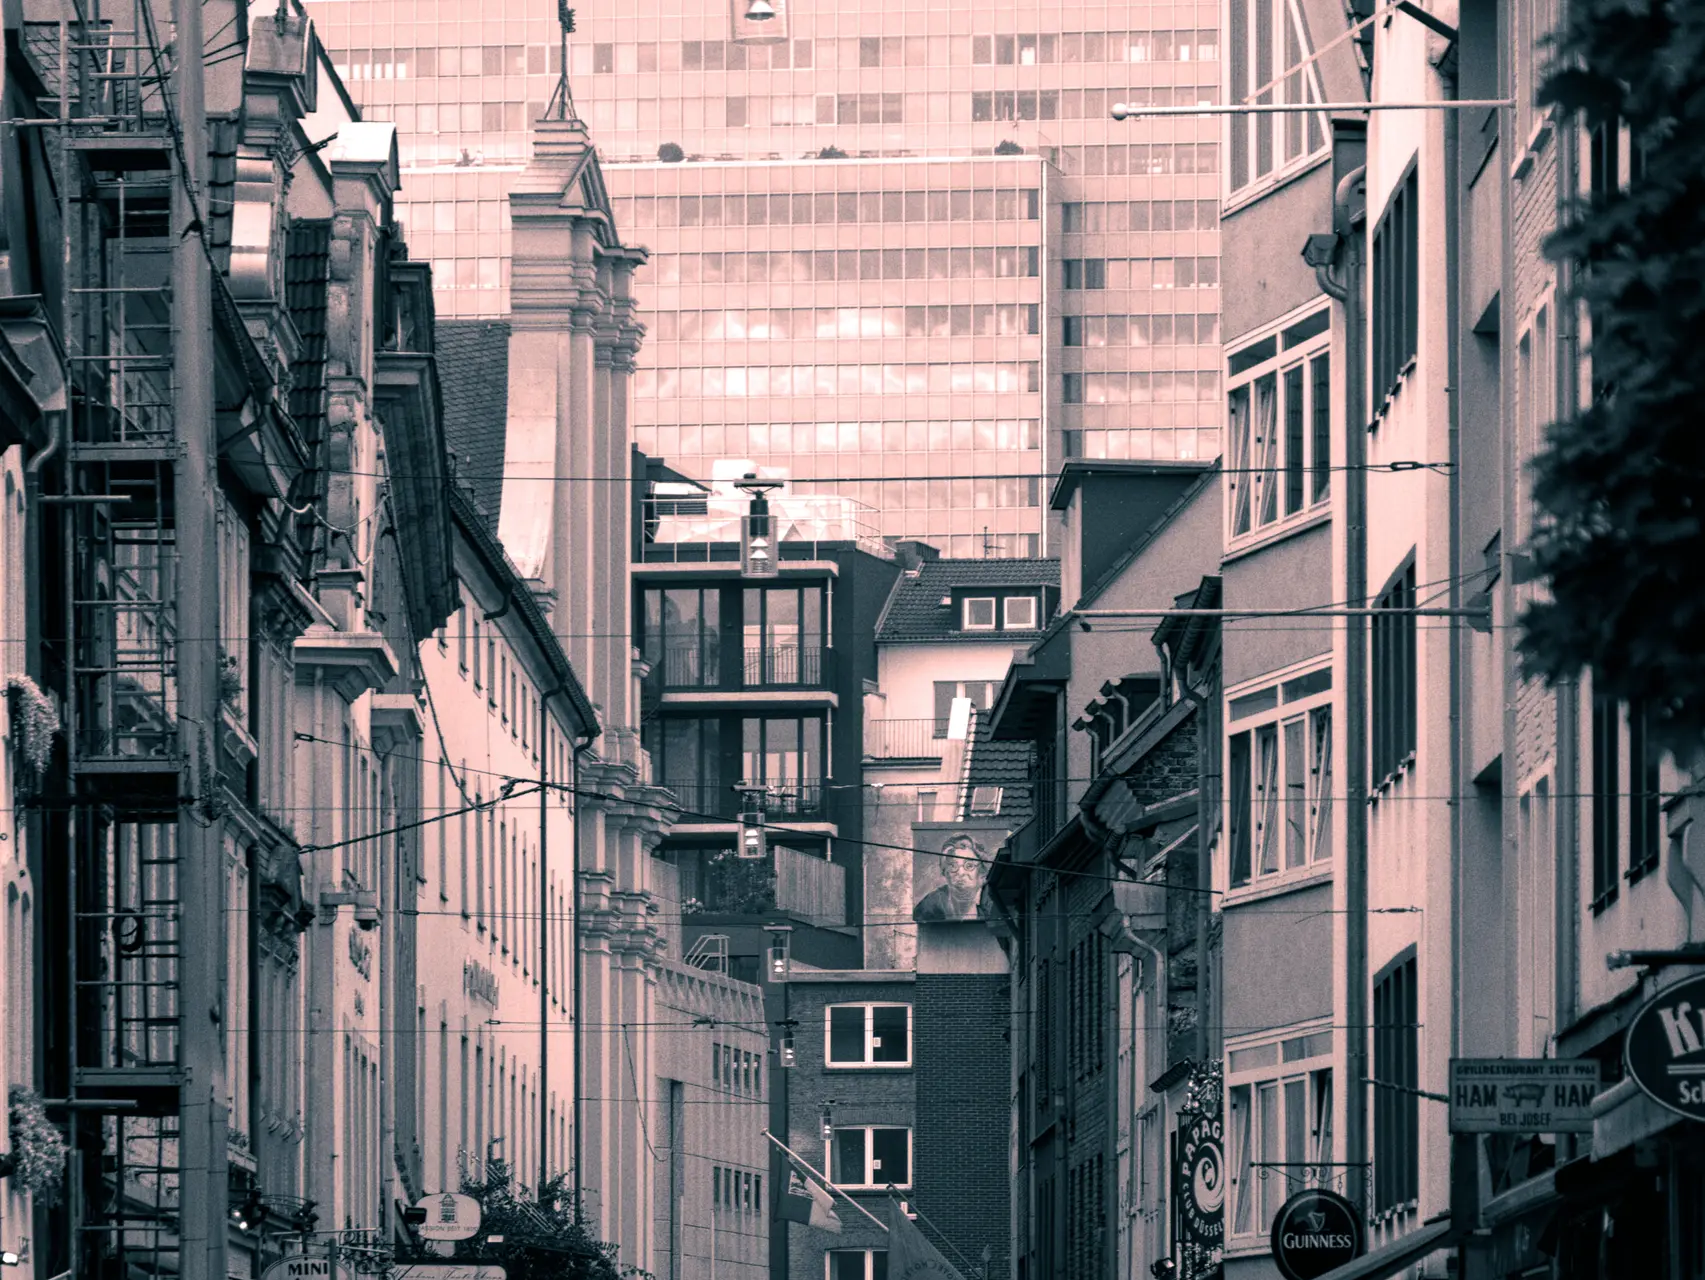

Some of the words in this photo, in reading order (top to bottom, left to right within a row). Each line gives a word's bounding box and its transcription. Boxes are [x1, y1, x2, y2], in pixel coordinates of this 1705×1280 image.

[1657, 1001, 1705, 1058] K
[1456, 1064, 1545, 1076] GRILLRESTAURANT
[1548, 1064, 1571, 1076] SEIT
[1456, 1084, 1498, 1108] HAM
[1554, 1084, 1596, 1108] HAM
[1499, 1112, 1517, 1127] BEI
[1519, 1112, 1552, 1127] JOSEF
[1182, 1181, 1196, 1220] CLUB
[1282, 1232, 1353, 1249] GUINNESS
[287, 1262, 329, 1276] MINI
